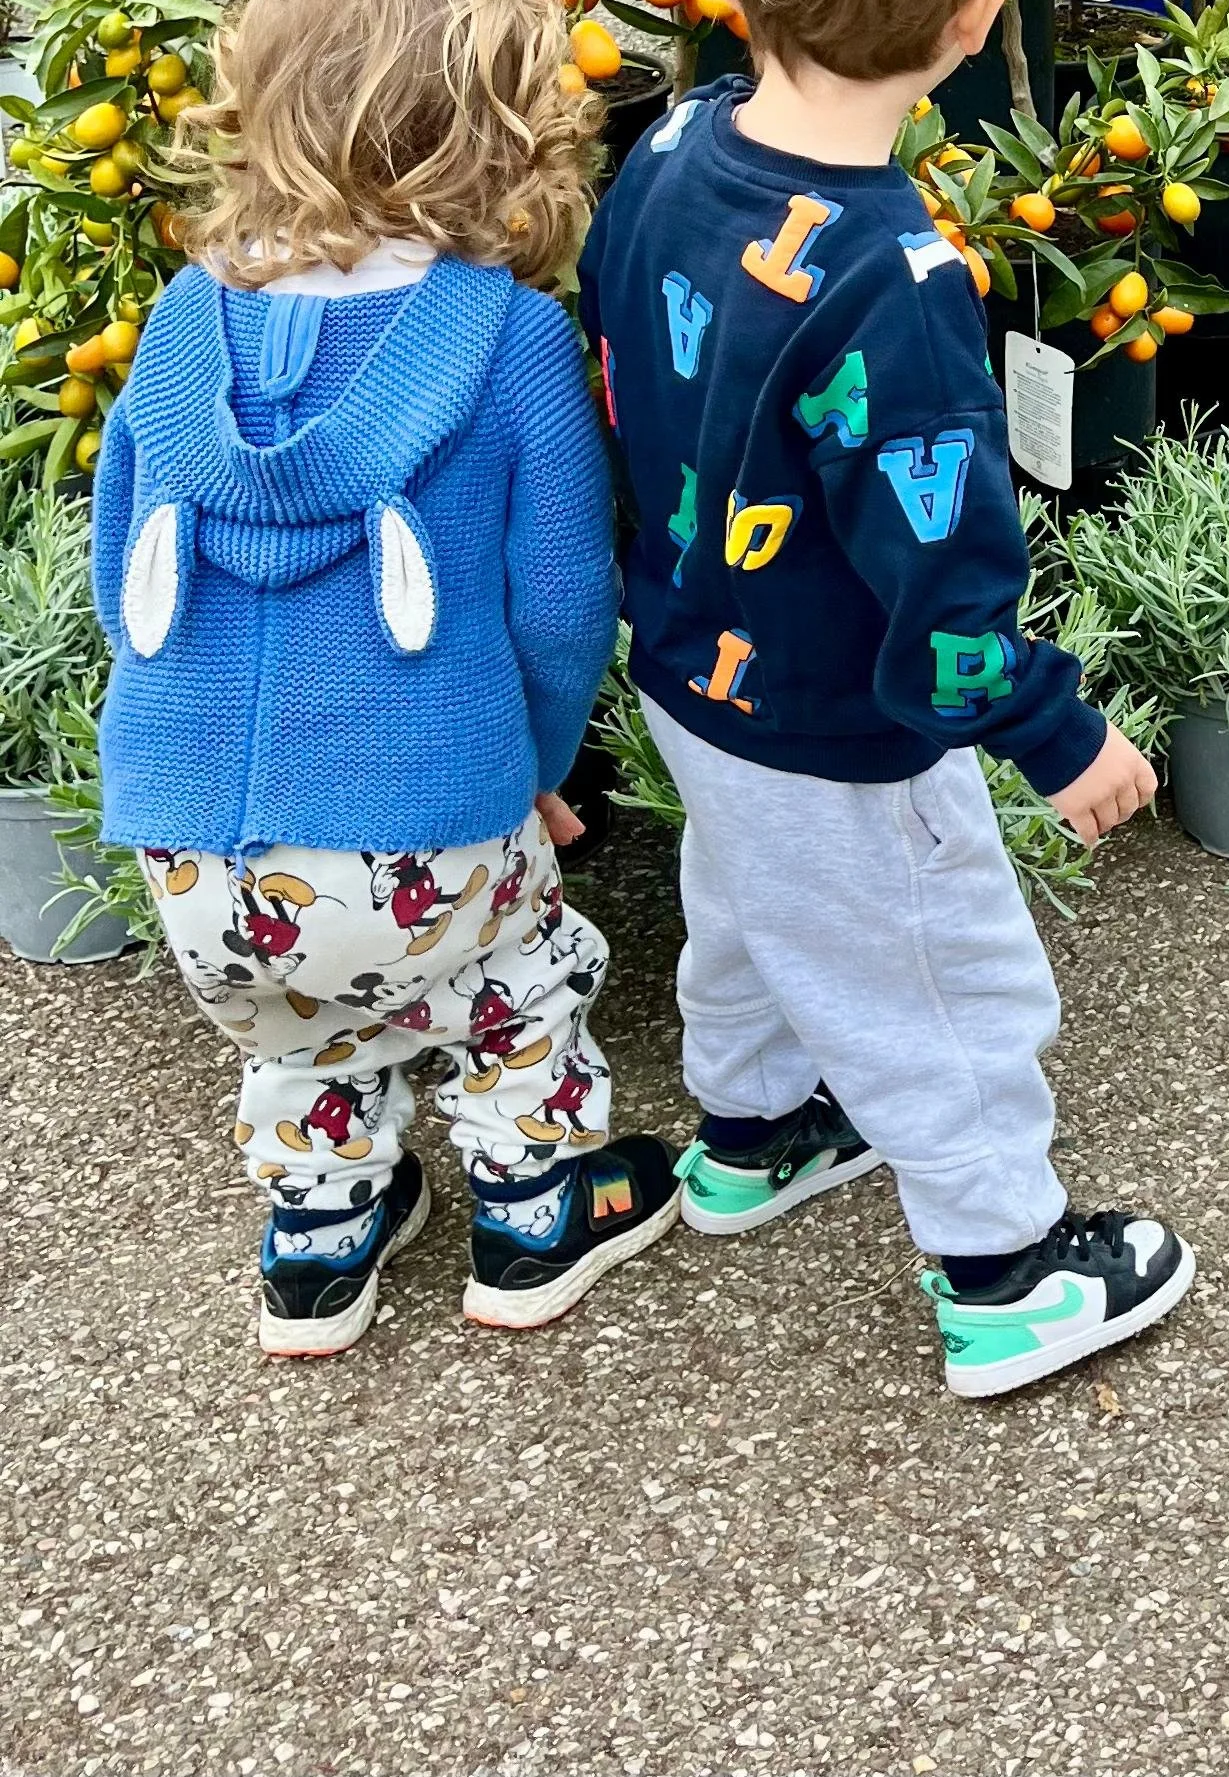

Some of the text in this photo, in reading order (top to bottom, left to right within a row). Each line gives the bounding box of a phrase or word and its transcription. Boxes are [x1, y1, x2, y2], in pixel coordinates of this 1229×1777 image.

[661, 270, 714, 380] A
[877, 428, 975, 544] A
[930, 631, 1017, 717] R
